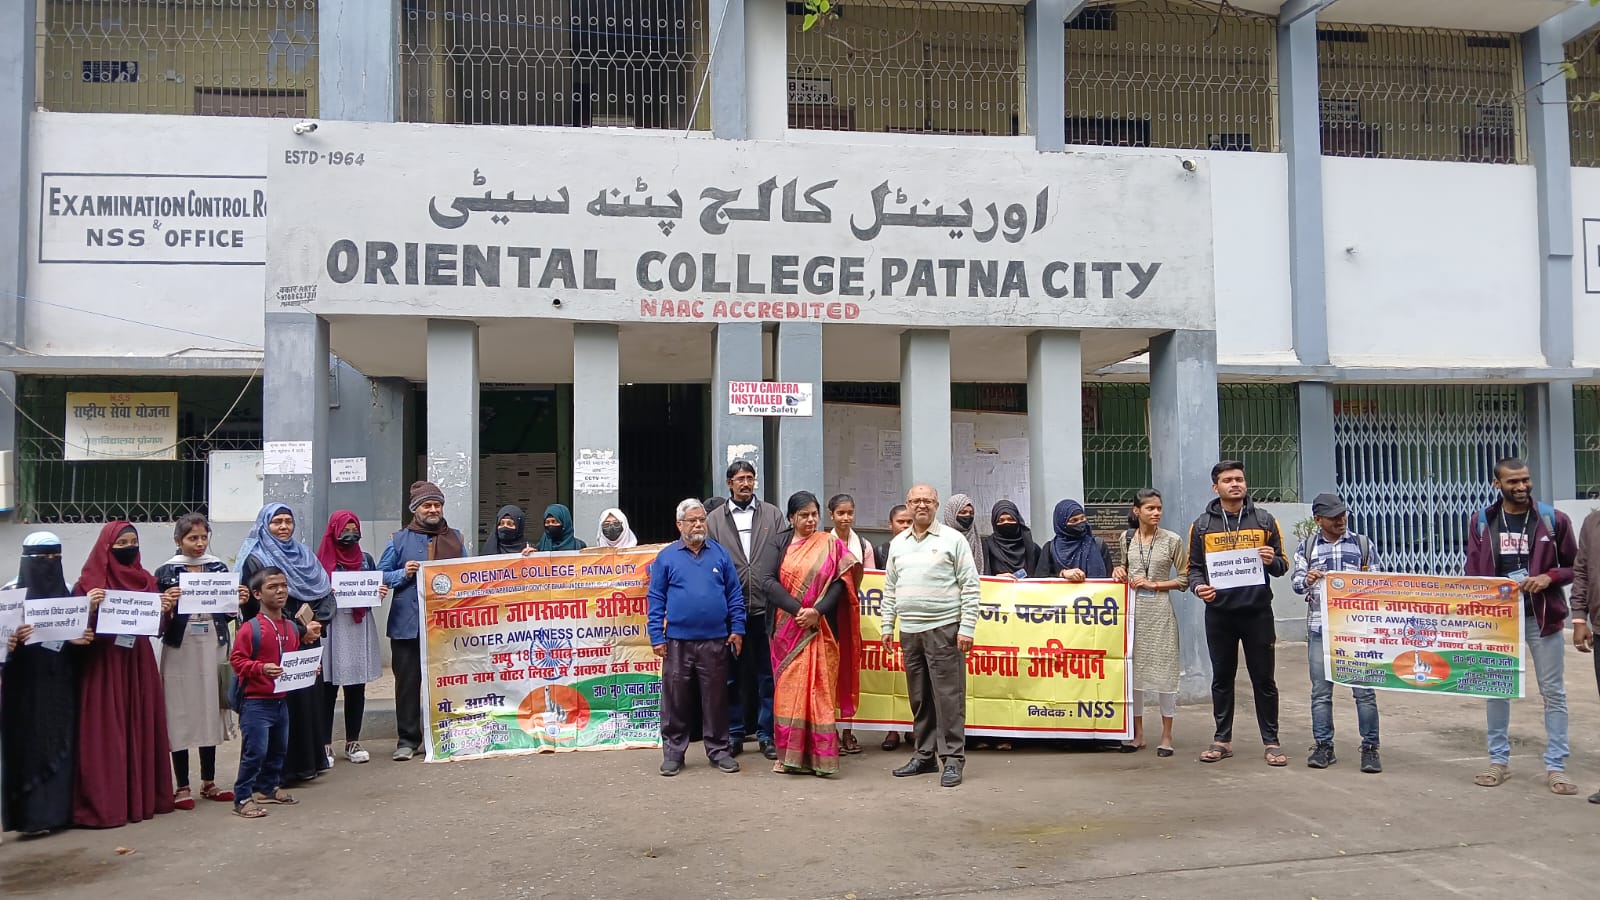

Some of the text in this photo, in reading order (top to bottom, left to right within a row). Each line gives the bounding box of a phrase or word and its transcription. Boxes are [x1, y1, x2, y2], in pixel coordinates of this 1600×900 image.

[50, 187, 186, 217] EXAMINATION
[187, 189, 250, 218] CONTROL
[152, 219, 163, 230] &
[87, 229, 243, 247] NSS OFFICE
[327, 239, 616, 290] ORIENTAL
[881, 257, 1030, 299] PATNA
[1041, 260, 1162, 300] CITY
[641, 299, 861, 320] NAAC ACCREDITED
[731, 383, 799, 394] CCTV CAMERA
[731, 394, 783, 405] INSTALLED
[771, 406, 798, 415] Safety
[461, 567, 517, 584] ORIENTAL
[581, 565, 613, 576] PATNA
[615, 564, 637, 575] CITY
[1352, 578, 1393, 588] ORIENTAL
[433, 604, 500, 629] मतदाता
[596, 592, 649, 618] अभिया
[1015, 604, 1067, 624] पटना
[1072, 597, 1119, 626] सिटी
[1332, 597, 1379, 612] मतदाता
[1456, 601, 1513, 618] अभियान
[1352, 614, 1382, 623] VOTER
[1441, 619, 1492, 629] CAMPAIGN
[461, 633, 503, 647] VOTER
[577, 625, 640, 639] CAMPAIGN
[517, 650, 530, 661] 18
[1028, 639, 1107, 680] अभियान
[436, 674, 468, 688] अपना
[472, 671, 496, 683] नाम
[573, 664, 607, 677] अवश्य
[1028, 705, 1066, 717] निवेदक
[1077, 701, 1114, 719] NSS
